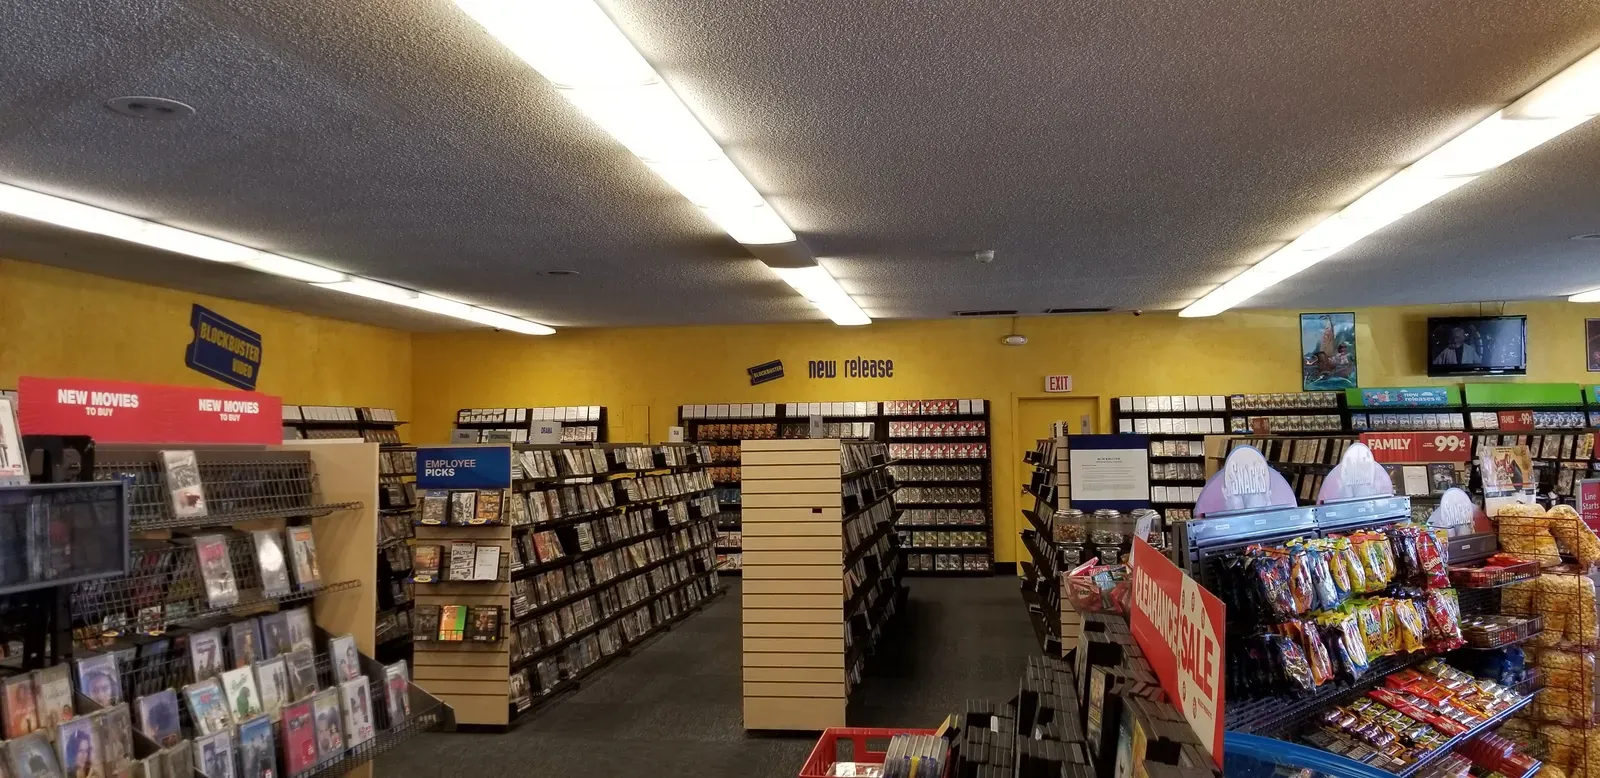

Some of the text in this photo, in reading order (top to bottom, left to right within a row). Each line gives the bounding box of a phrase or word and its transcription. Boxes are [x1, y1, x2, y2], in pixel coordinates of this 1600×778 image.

[200, 322, 260, 363] BLOCKBUSTER
[232, 357, 253, 379] VIDEO
[753, 365, 782, 378] BLOCKBUSTER
[808, 356, 894, 378] new release
[1049, 376, 1069, 390] EXIT
[57, 389, 139, 408] NEW MOVIES
[86, 407, 113, 417] TO BUY
[198, 398, 259, 414] NEW MOVIES
[219, 413, 240, 422] TO BUY
[1367, 438, 1411, 450] FAMILY
[425, 459, 476, 468] EMPLOYEE
[425, 468, 455, 477] PICKS
[1230, 461, 1267, 495] SNACKS
[1584, 493, 1597, 501] Line
[1582, 502, 1600, 510] Starts
[1135, 566, 1180, 651] CLEARANCE
[1180, 614, 1213, 701] SALE
